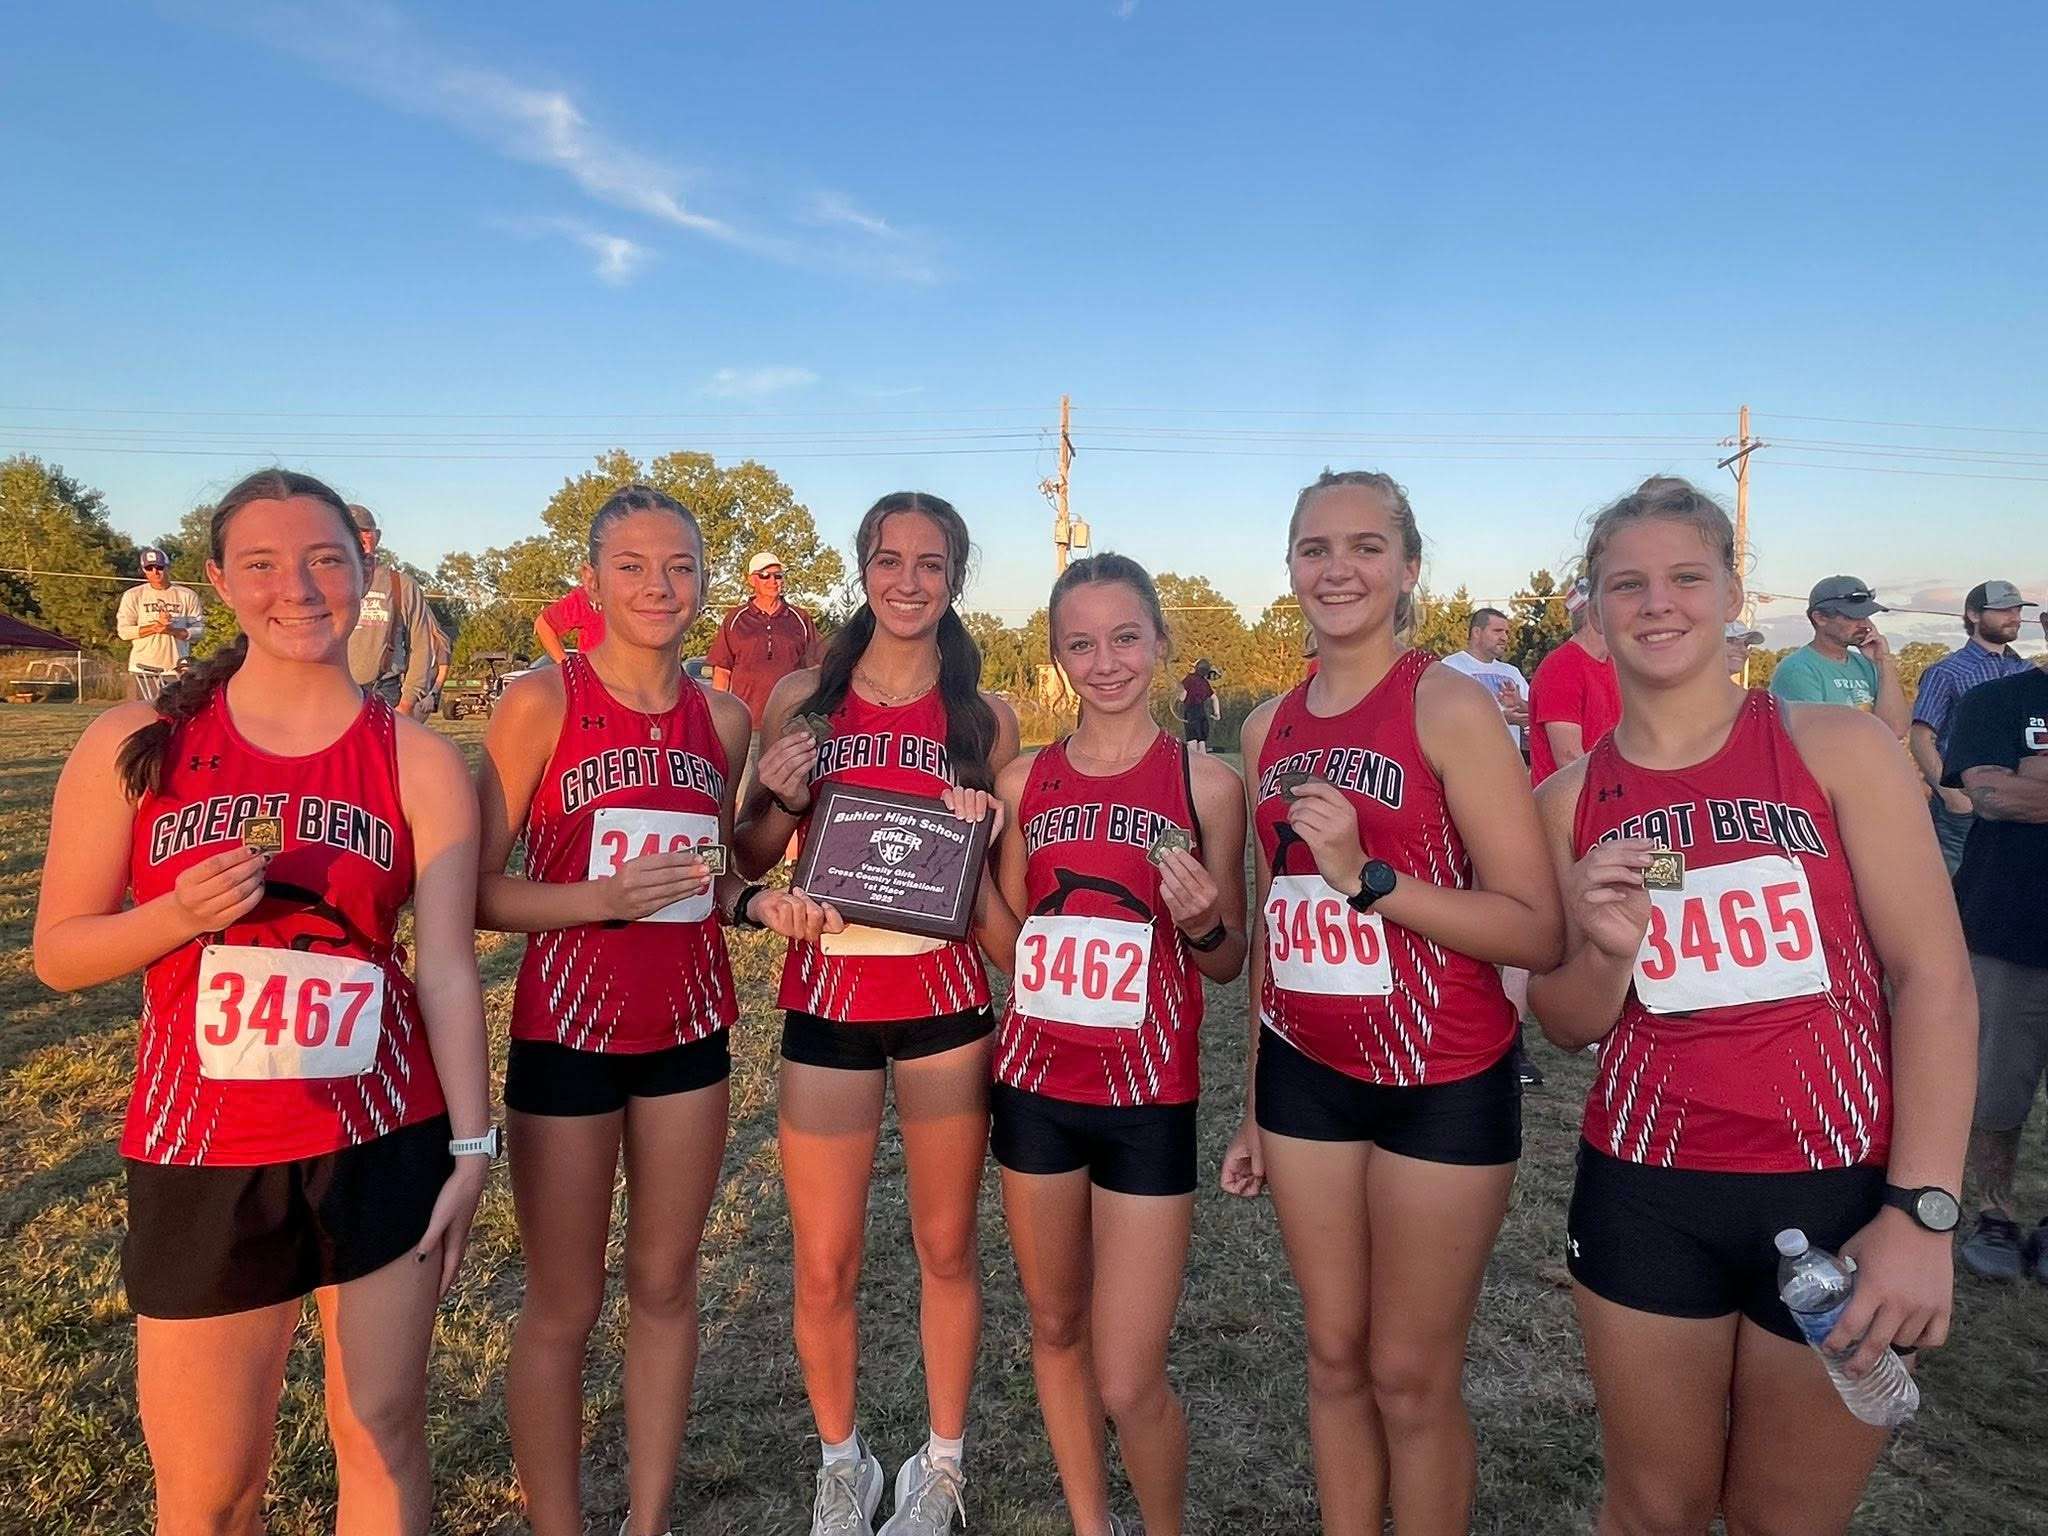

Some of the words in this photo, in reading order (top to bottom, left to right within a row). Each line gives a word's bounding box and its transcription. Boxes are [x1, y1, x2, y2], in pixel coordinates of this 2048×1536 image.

[560, 746, 660, 815] GREAT
[813, 732, 893, 783] REAT
[899, 734, 956, 788] BEN
[1258, 749, 1324, 805] REAT
[1324, 748, 1404, 810] BEND
[150, 793, 290, 867] GREAT
[296, 796, 394, 872] BEND
[833, 812, 882, 823] Buhler
[884, 812, 917, 826] High
[919, 819, 965, 844] School
[869, 830, 923, 851] BUHLER
[882, 843, 905, 861] XC
[1107, 804, 1180, 850] BEN
[1706, 798, 1829, 858] BEND
[828, 866, 855, 878] Cross
[855, 871, 892, 885] Country
[893, 877, 945, 893] Invitational
[861, 863, 893, 876] Varsity
[894, 868, 916, 879] Girls
[863, 882, 878, 892] 1st
[879, 884, 905, 896] Place
[870, 892, 893, 903] 2025
[1269, 898, 1380, 965] 3466
[1641, 882, 1813, 980] 3465
[1022, 934, 1143, 1003] 3462
[204, 971, 374, 1047] 3467
